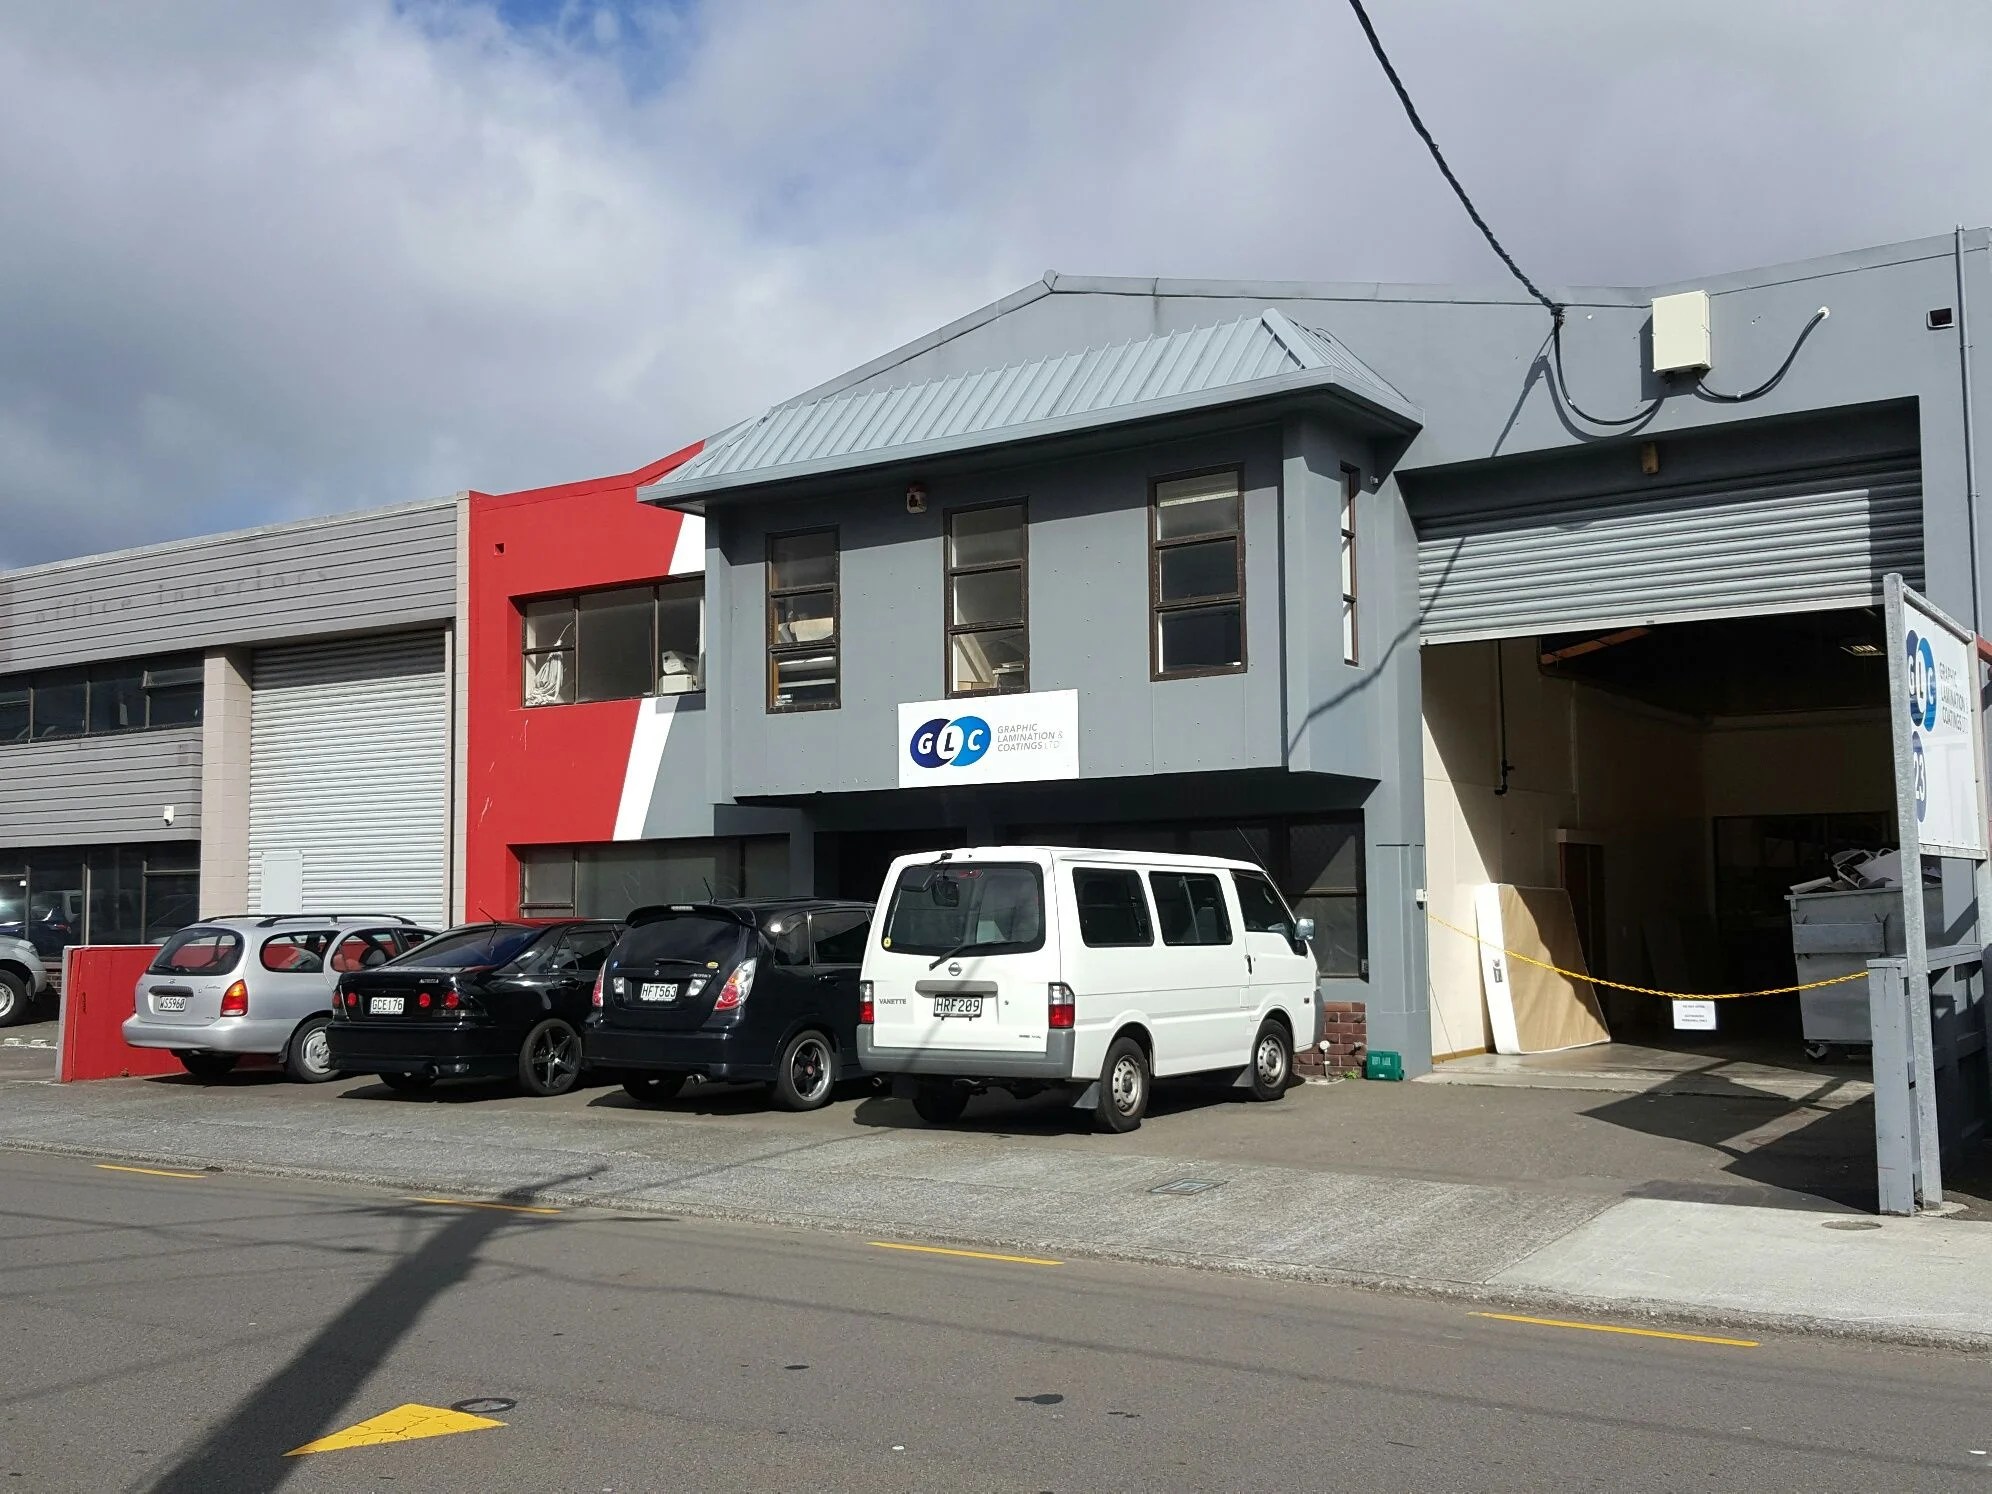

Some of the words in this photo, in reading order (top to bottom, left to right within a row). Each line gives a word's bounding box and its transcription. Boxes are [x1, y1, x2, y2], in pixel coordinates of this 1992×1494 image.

[997, 723, 1038, 734] GRAPHIC
[917, 729, 984, 755] GLC
[997, 731, 1055, 743] LAMINATION
[1057, 730, 1063, 739] &
[997, 741, 1043, 752] COATINGS
[1044, 740, 1060, 750] LTD
[1913, 752, 1926, 802] 23
[641, 985, 677, 998] HFT563
[372, 999, 403, 1011] GCE176
[935, 998, 980, 1012] HRF209
